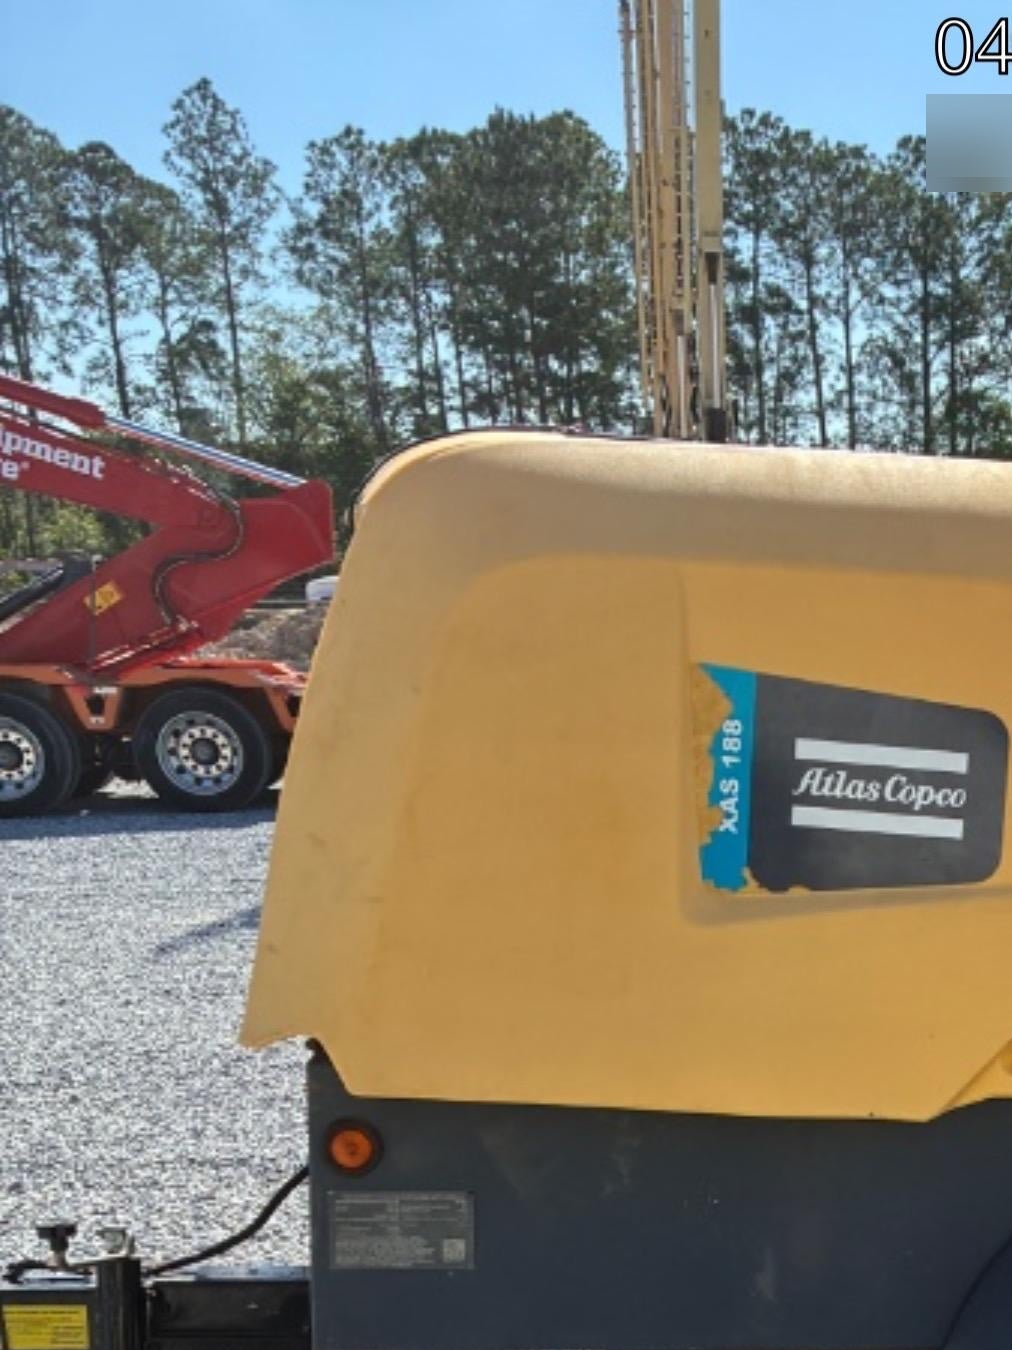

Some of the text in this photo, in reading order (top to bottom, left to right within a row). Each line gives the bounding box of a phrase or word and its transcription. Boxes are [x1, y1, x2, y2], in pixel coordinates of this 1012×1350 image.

[718, 718, 743, 834] XAS 188
[792, 767, 968, 811] Atlas Copco
